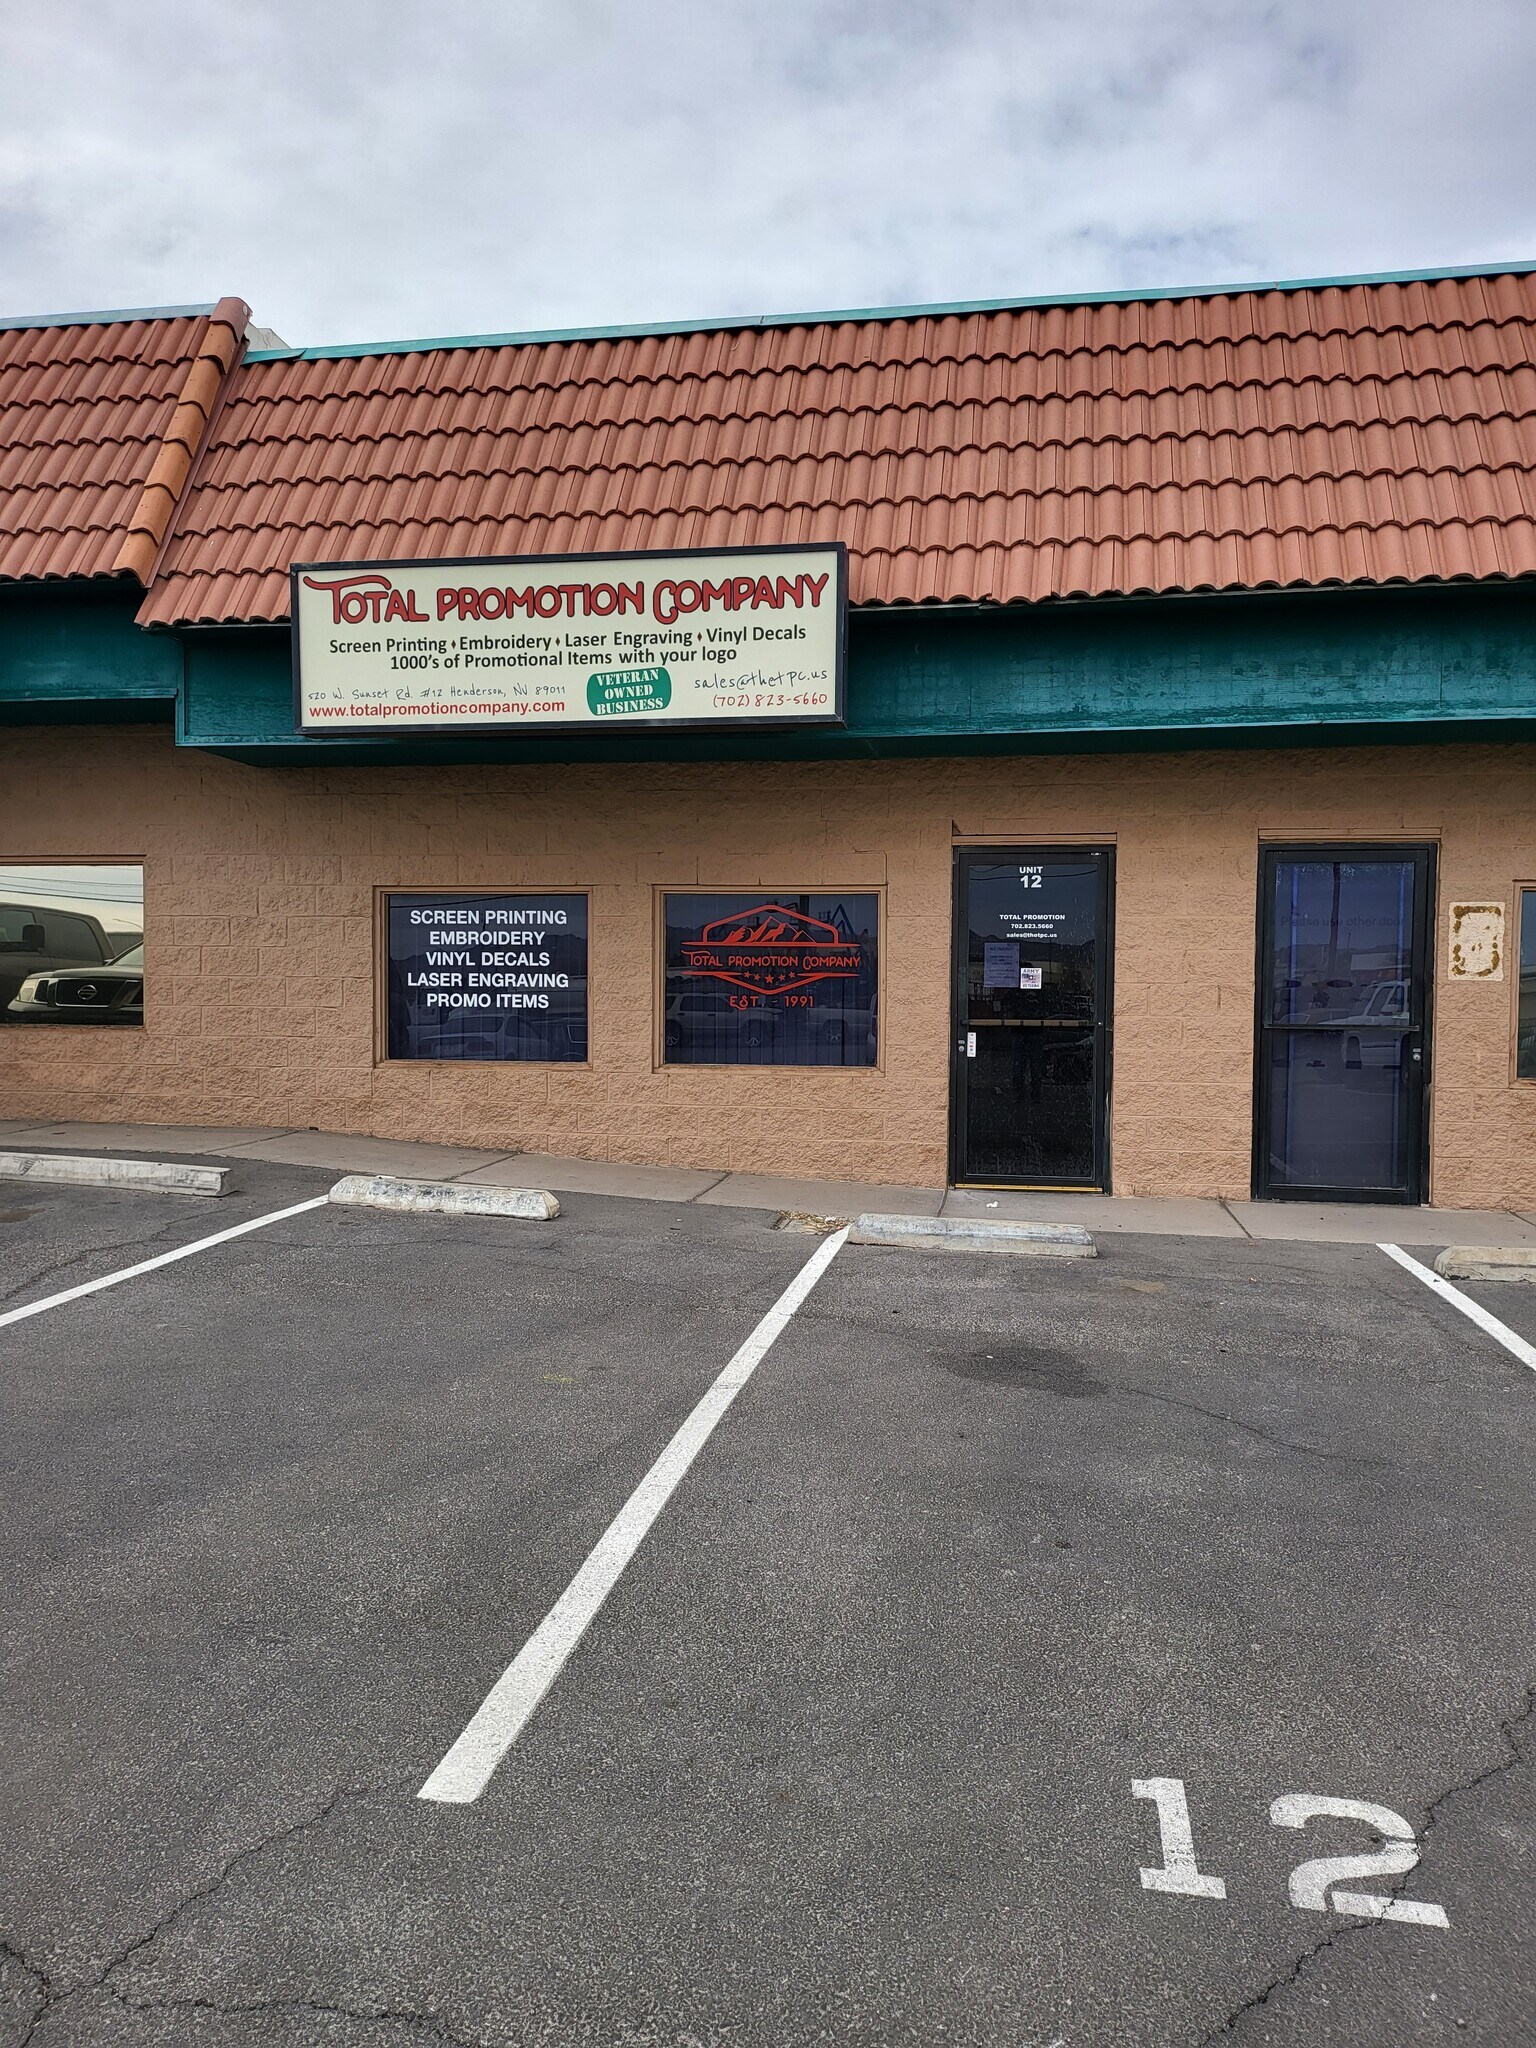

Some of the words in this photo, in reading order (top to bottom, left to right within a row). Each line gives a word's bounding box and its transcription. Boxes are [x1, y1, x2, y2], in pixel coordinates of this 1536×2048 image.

[303, 575, 430, 624] TOTAL
[436, 581, 645, 621] PROMOTION
[652, 572, 829, 625] COMPANY
[330, 638, 381, 654] Screen
[387, 636, 447, 655] Printing
[460, 634, 551, 653] Embroidery
[565, 632, 607, 647] Laser
[614, 630, 693, 648] Engraving
[706, 626, 747, 645] Vinyl
[752, 624, 807, 641] Decals
[390, 655, 439, 671] 1000's
[444, 653, 460, 669] of
[465, 651, 562, 669] Promotional
[568, 650, 612, 665] Items
[618, 648, 655, 664] with
[660, 648, 697, 665] your
[702, 646, 737, 664] logo
[596, 669, 660, 687] VETERAN
[694, 668, 828, 691] sales@thetpc.us
[308, 691, 327, 700] 520
[332, 687, 345, 700] W.
[352, 688, 388, 699] Sunset
[396, 686, 413, 700] Rd.
[420, 688, 443, 698] #12
[450, 682, 507, 698] Henderson,
[513, 682, 528, 696] NV
[535, 686, 566, 696] 89011
[604, 684, 653, 701] OWNED
[596, 697, 664, 715] BUSINESS
[713, 694, 750, 708] (702)
[754, 693, 828, 707] 823-5660
[309, 701, 565, 719] www.totalpromotioncompany.com
[1019, 866, 1043, 874] UNIT
[1020, 875, 1042, 888] 12
[410, 910, 480, 925] SCREEN
[485, 910, 567, 925] PRINTING
[429, 931, 546, 946] EMBROIDERY
[426, 952, 475, 966] VINYL
[481, 952, 550, 967] DECALS
[681, 949, 723, 966] TOTAL
[728, 954, 799, 967] PROMOTION
[803, 954, 861, 971] COMPANY
[407, 972, 462, 987] LASER
[468, 973, 569, 988] ENGRAVING
[426, 993, 491, 1008] PROMO
[496, 994, 549, 1009] ITEMS
[784, 995, 814, 1008] 1991
[1131, 1777, 1450, 1928] 12
